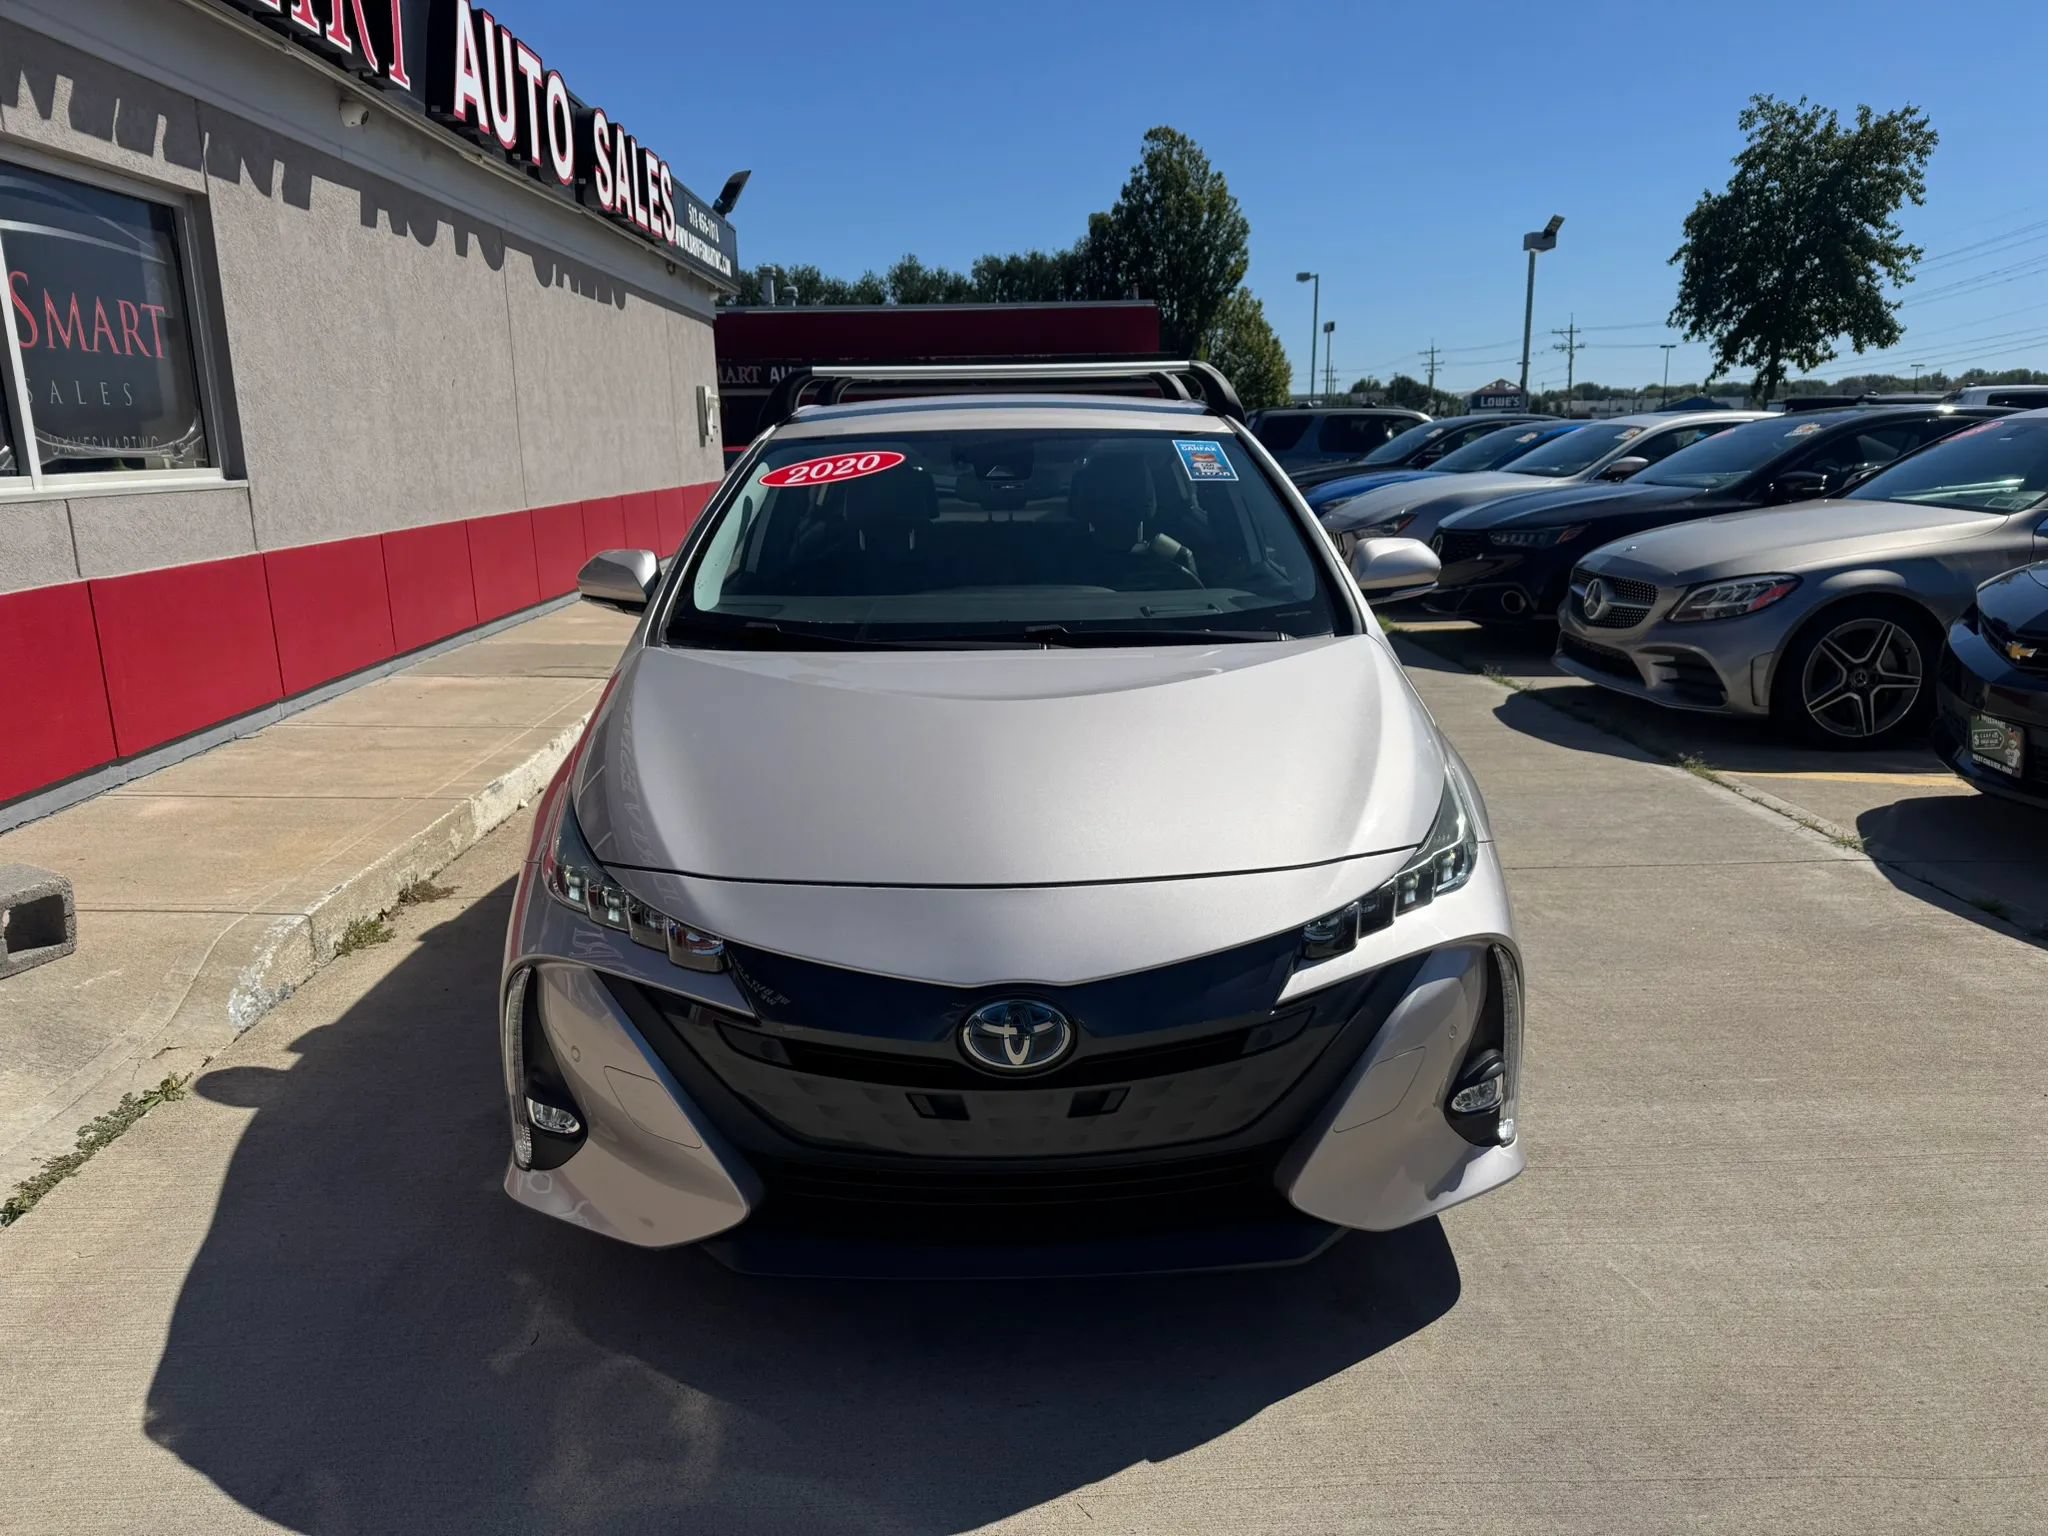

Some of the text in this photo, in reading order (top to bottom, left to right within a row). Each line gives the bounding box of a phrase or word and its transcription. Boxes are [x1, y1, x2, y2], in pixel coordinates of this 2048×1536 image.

[454, 0, 574, 185] AUTO
[593, 107, 677, 246] SALES
[9, 271, 166, 359] SMART
[784, 454, 880, 484] 2020
